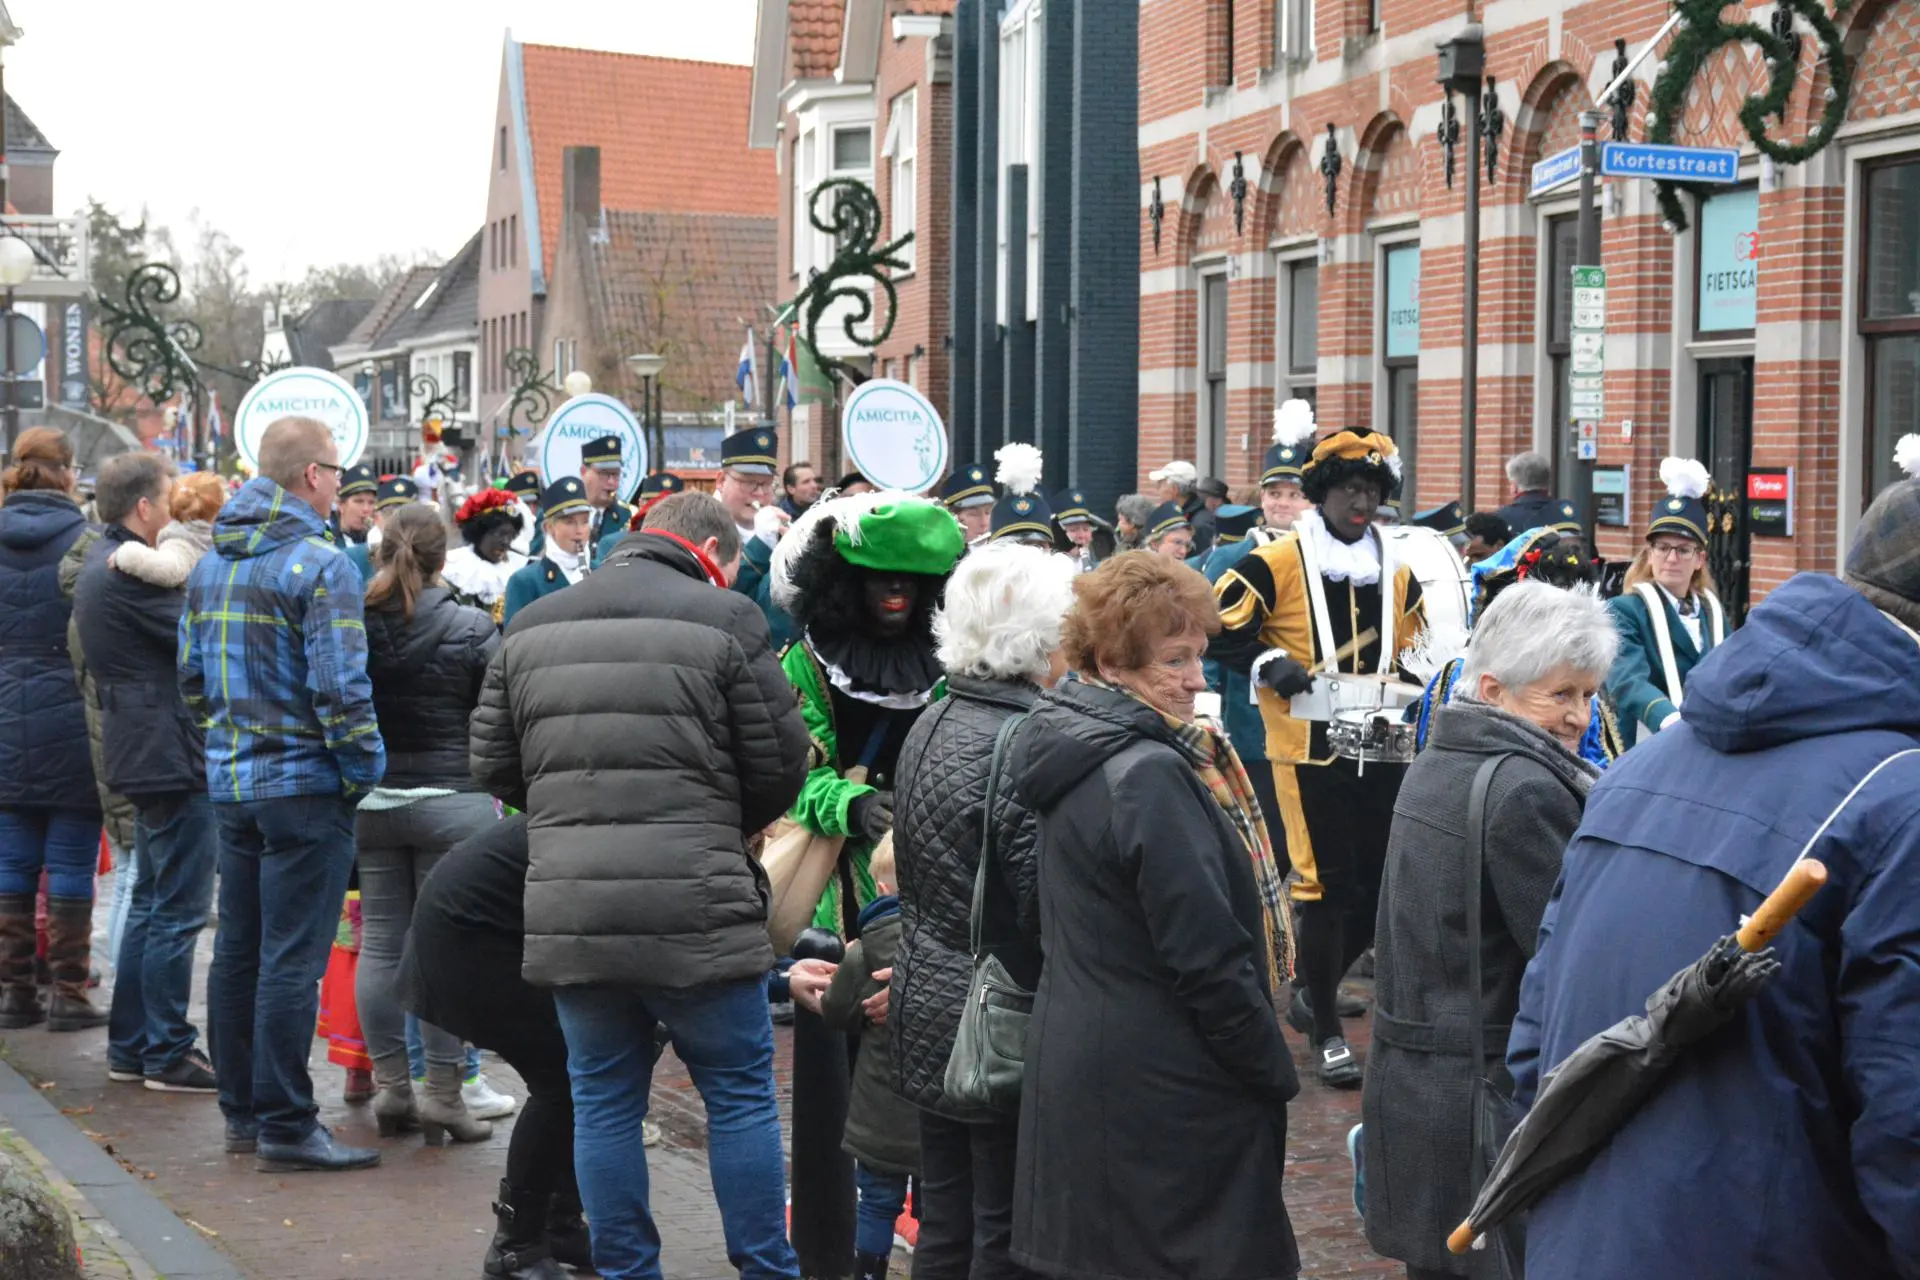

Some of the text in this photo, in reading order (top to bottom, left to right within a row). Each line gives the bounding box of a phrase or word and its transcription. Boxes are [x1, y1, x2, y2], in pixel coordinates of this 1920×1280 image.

[1613, 151, 1727, 174] Kortestraat
[1706, 269, 1755, 291] FIETSGA
[256, 398, 340, 413] AMICITIA
[857, 410, 922, 423] AMICITIA
